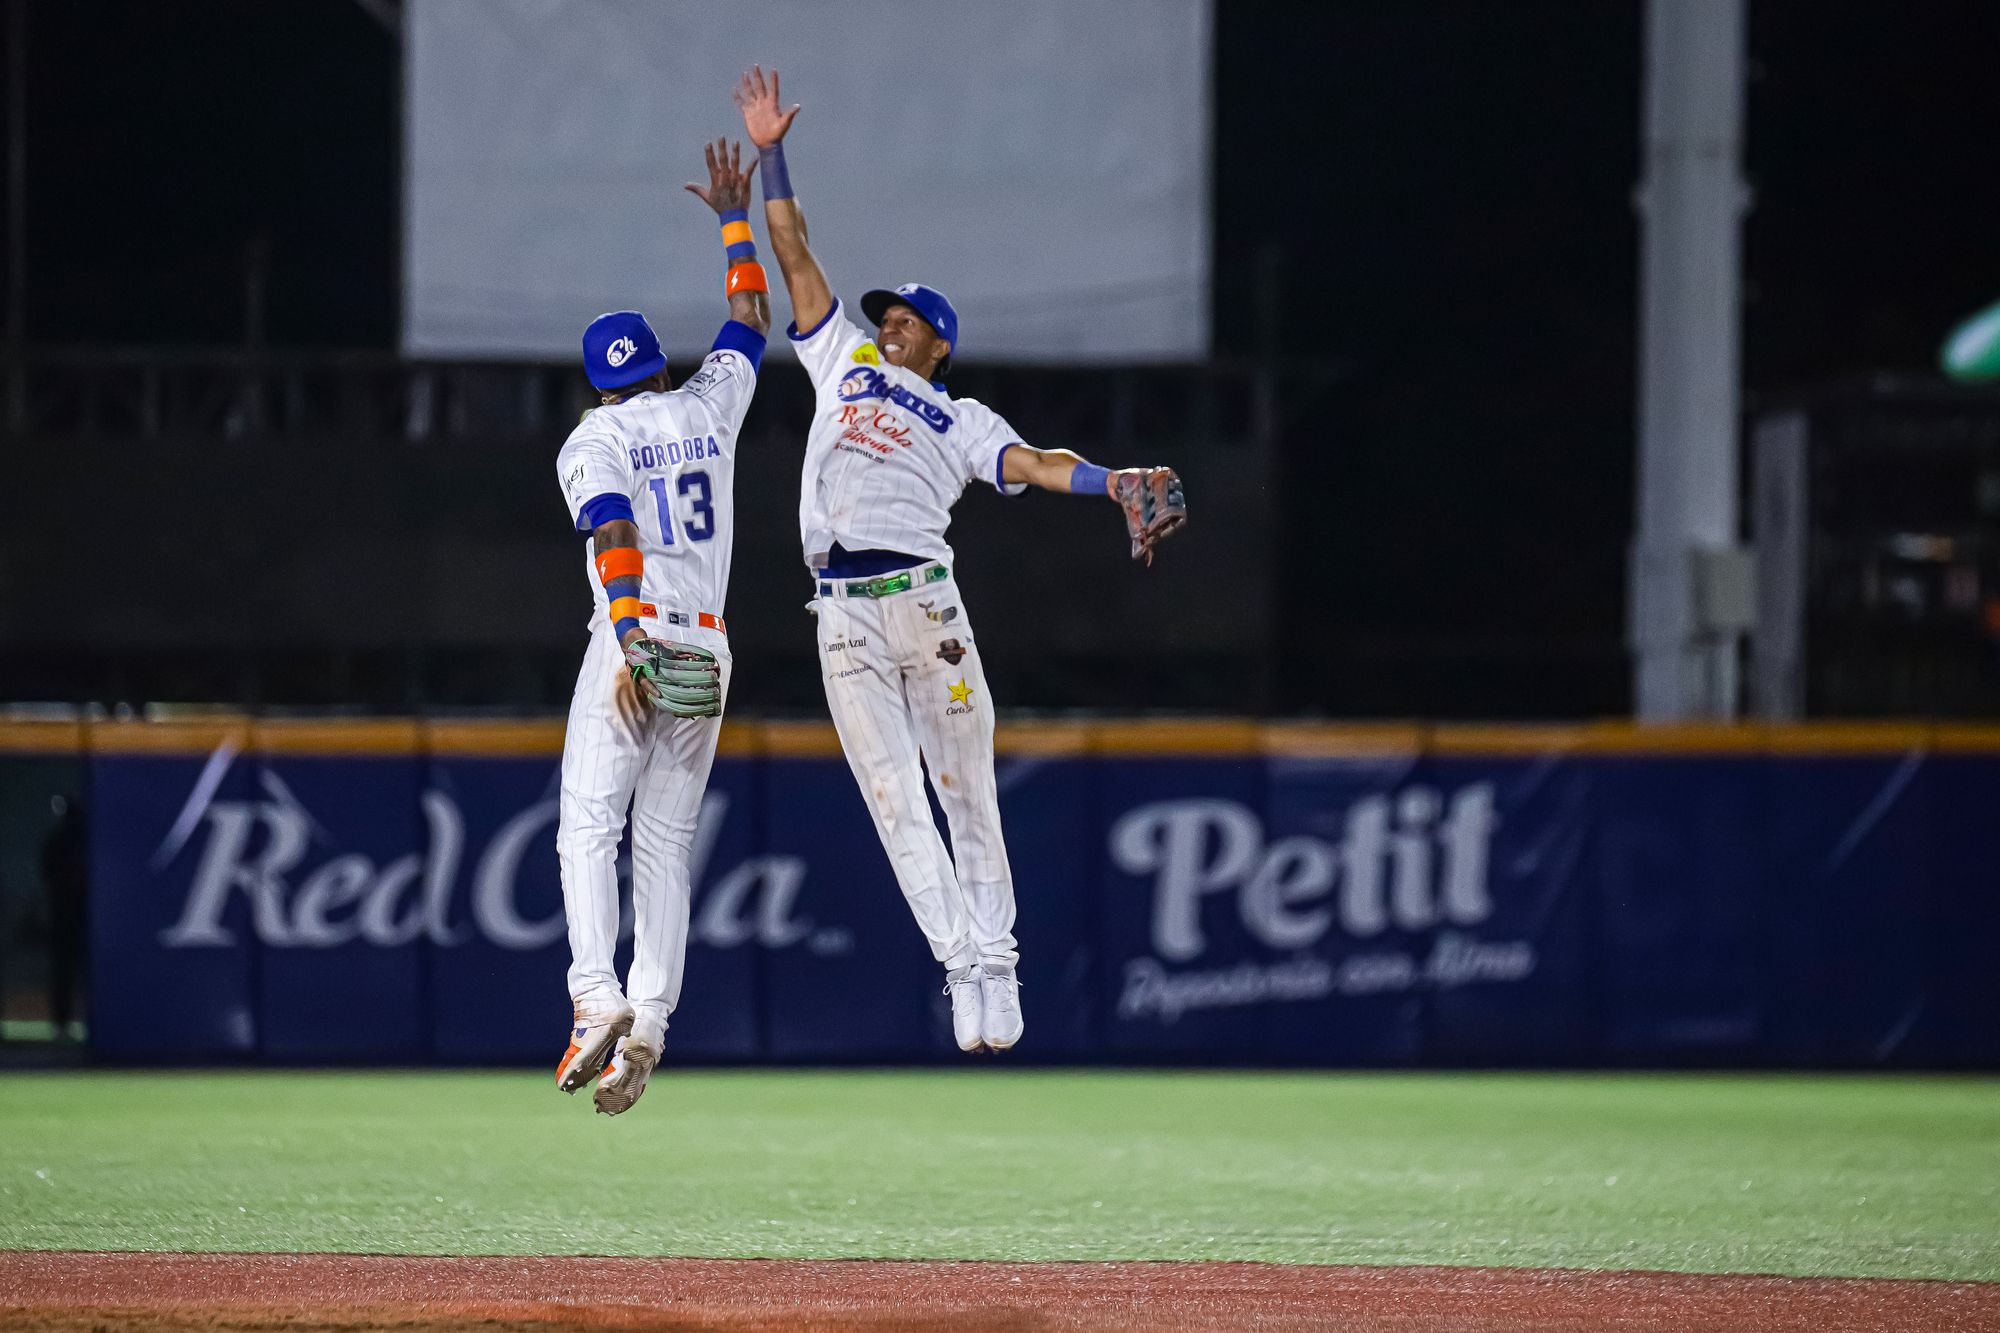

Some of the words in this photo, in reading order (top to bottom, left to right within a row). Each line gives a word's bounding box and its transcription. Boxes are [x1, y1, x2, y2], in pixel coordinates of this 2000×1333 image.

[606, 335, 638, 368] Ch
[629, 434, 721, 471] CORDOBA
[649, 471, 716, 546] 13
[847, 636, 867, 648] Azul
[158, 790, 470, 949] Red
[472, 788, 812, 949] Cla
[1108, 779, 1499, 961] Petit
